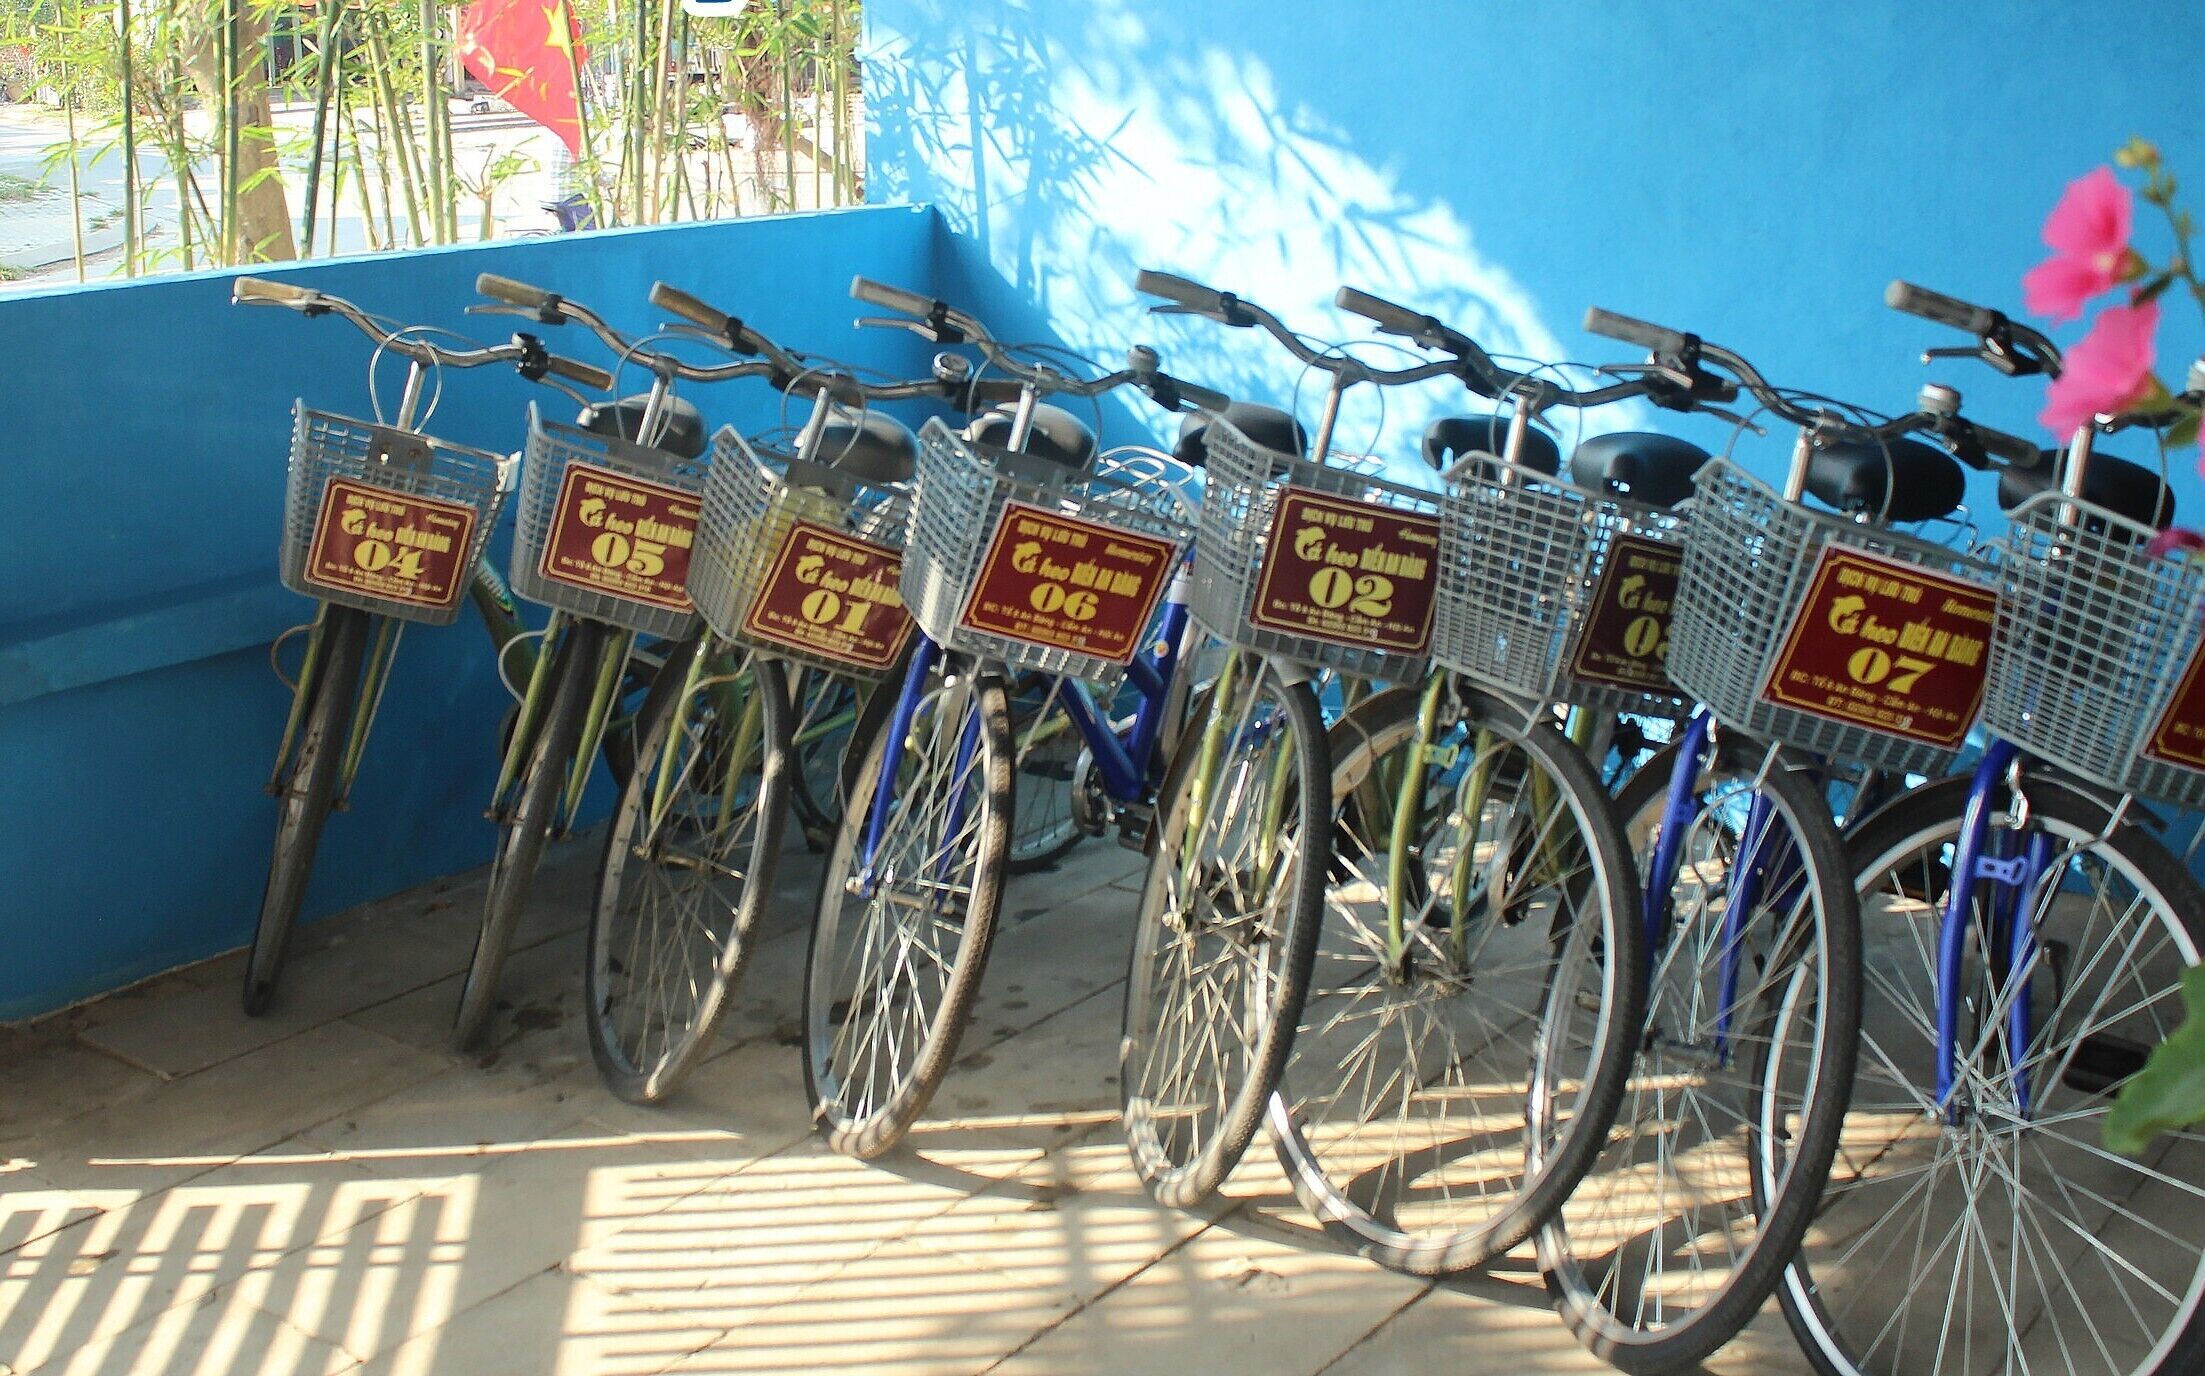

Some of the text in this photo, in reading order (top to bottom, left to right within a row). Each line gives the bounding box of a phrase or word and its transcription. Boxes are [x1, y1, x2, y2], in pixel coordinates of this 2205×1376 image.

[354, 540, 427, 580] 04
[592, 532, 667, 577] 05
[801, 589, 872, 636] 01
[1029, 582, 1100, 621] 06
[1309, 566, 1394, 618] 02
[1847, 647, 1937, 694] 07
